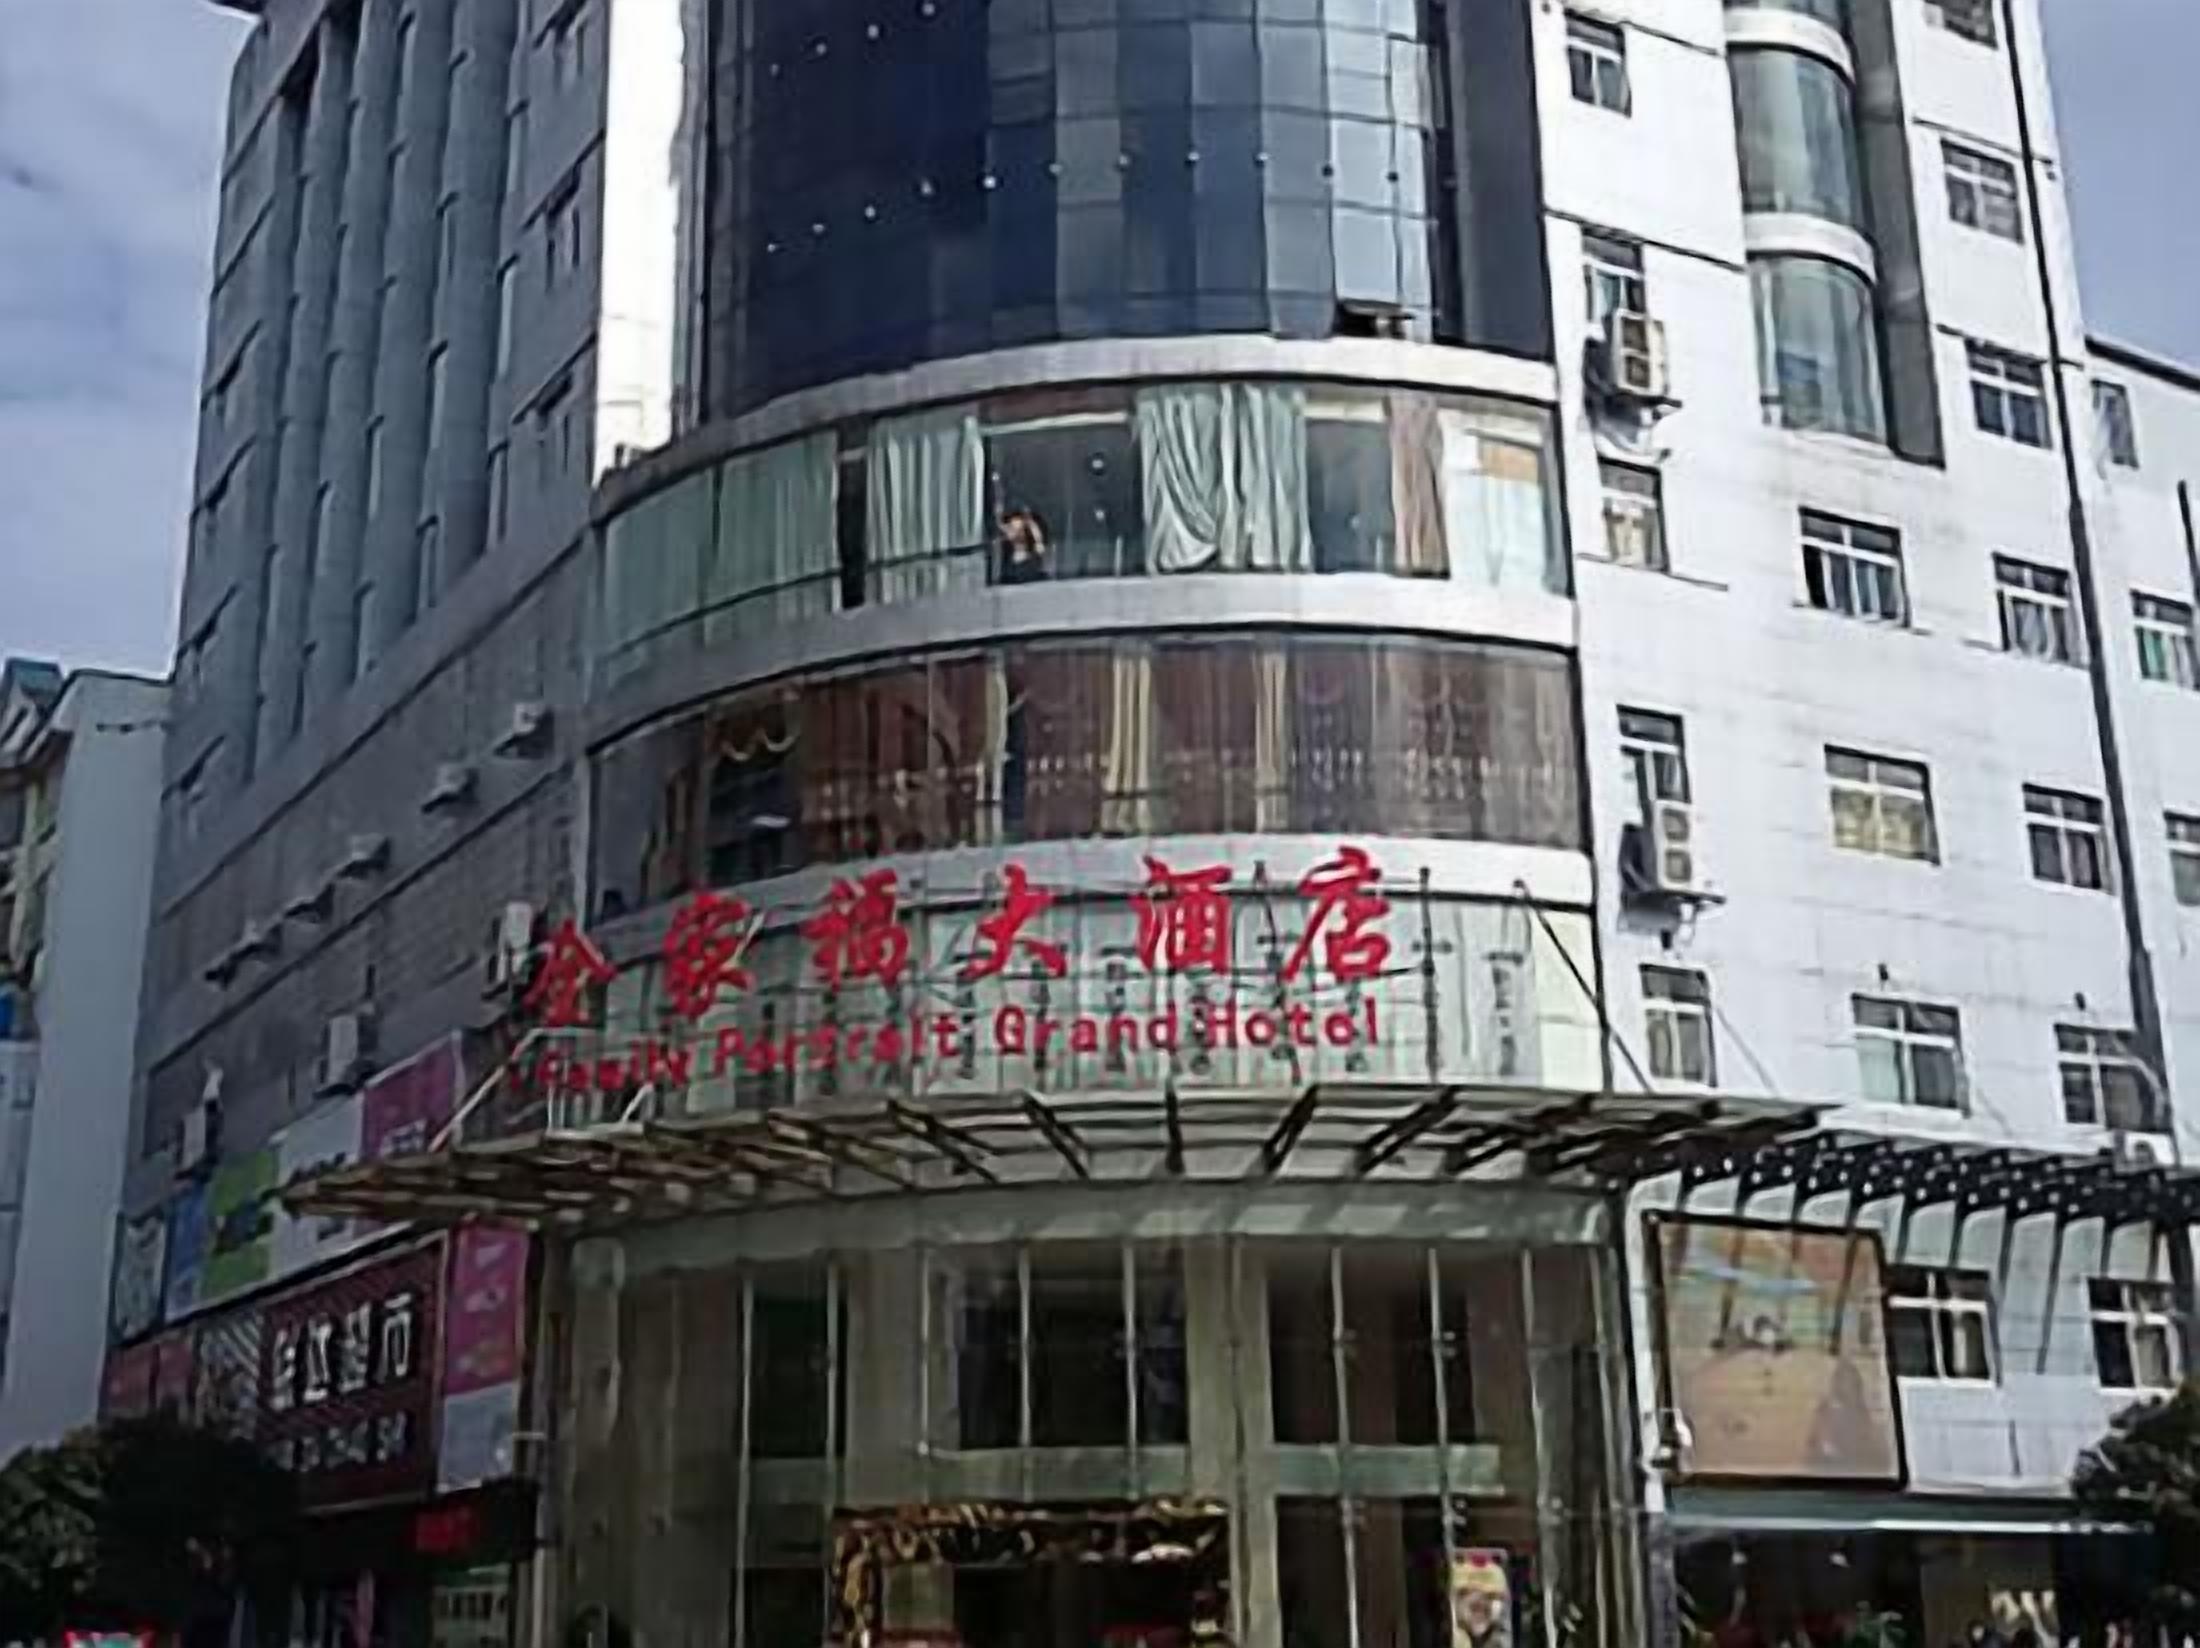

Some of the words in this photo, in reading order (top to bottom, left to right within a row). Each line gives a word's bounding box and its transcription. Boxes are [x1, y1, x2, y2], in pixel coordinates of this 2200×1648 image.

[522, 845, 1392, 1028] 全家福大酒店
[994, 1000, 1177, 1055] Grand
[1204, 996, 1379, 1049] Hotel
